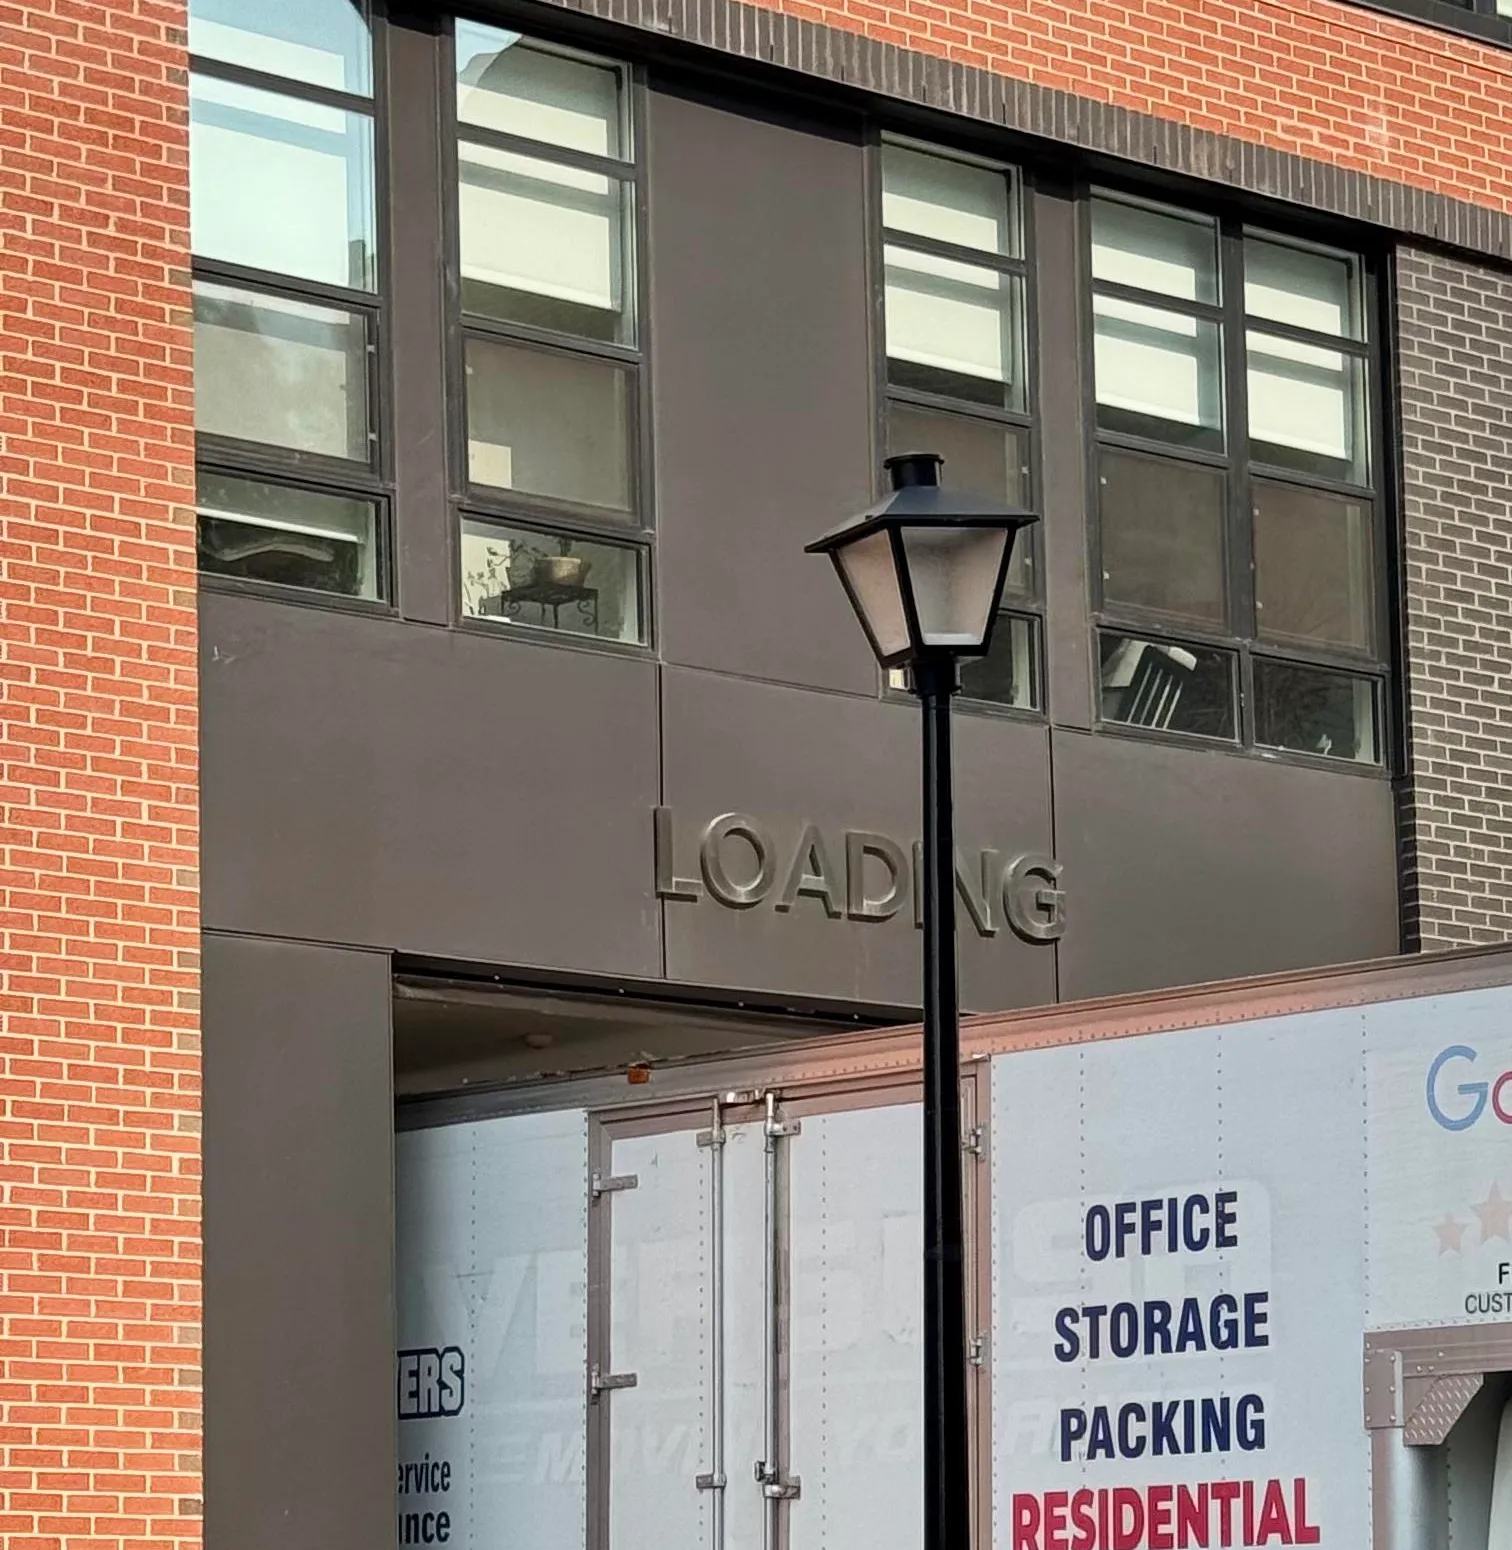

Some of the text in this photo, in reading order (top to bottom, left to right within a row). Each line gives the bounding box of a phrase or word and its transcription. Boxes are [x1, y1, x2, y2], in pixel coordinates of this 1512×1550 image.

[654, 805, 1067, 946] LOADING
[1086, 1191, 1238, 1261] OFFICE
[1054, 1291, 1269, 1363] STORAGE
[1060, 1394, 1266, 1462] PACKING
